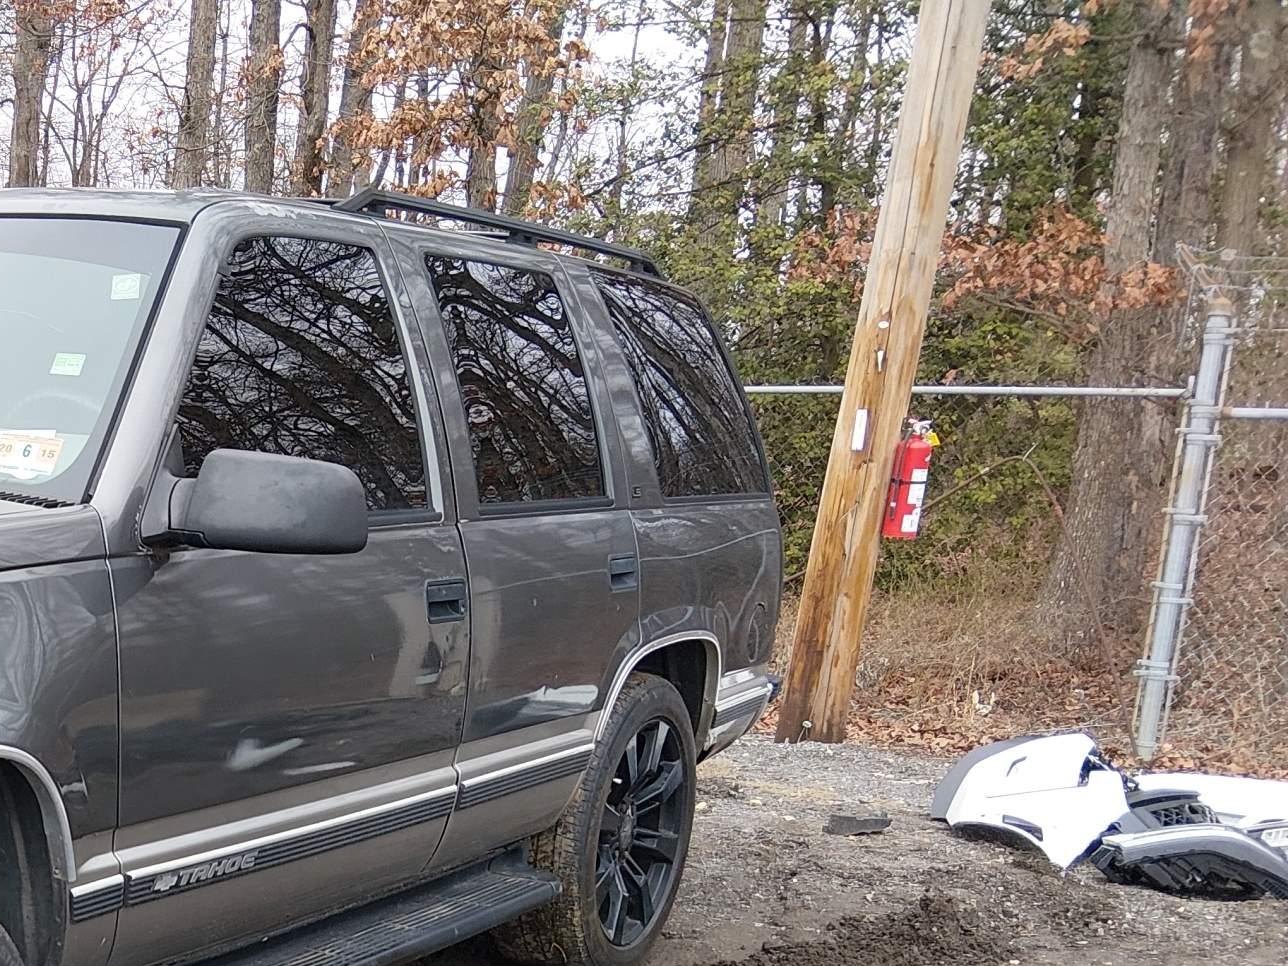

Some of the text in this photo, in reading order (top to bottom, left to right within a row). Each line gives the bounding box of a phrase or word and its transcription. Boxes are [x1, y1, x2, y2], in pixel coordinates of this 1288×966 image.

[23, 443, 33, 458] 6
[40, 449, 57, 459] 15
[179, 850, 259, 886] TAHOE
